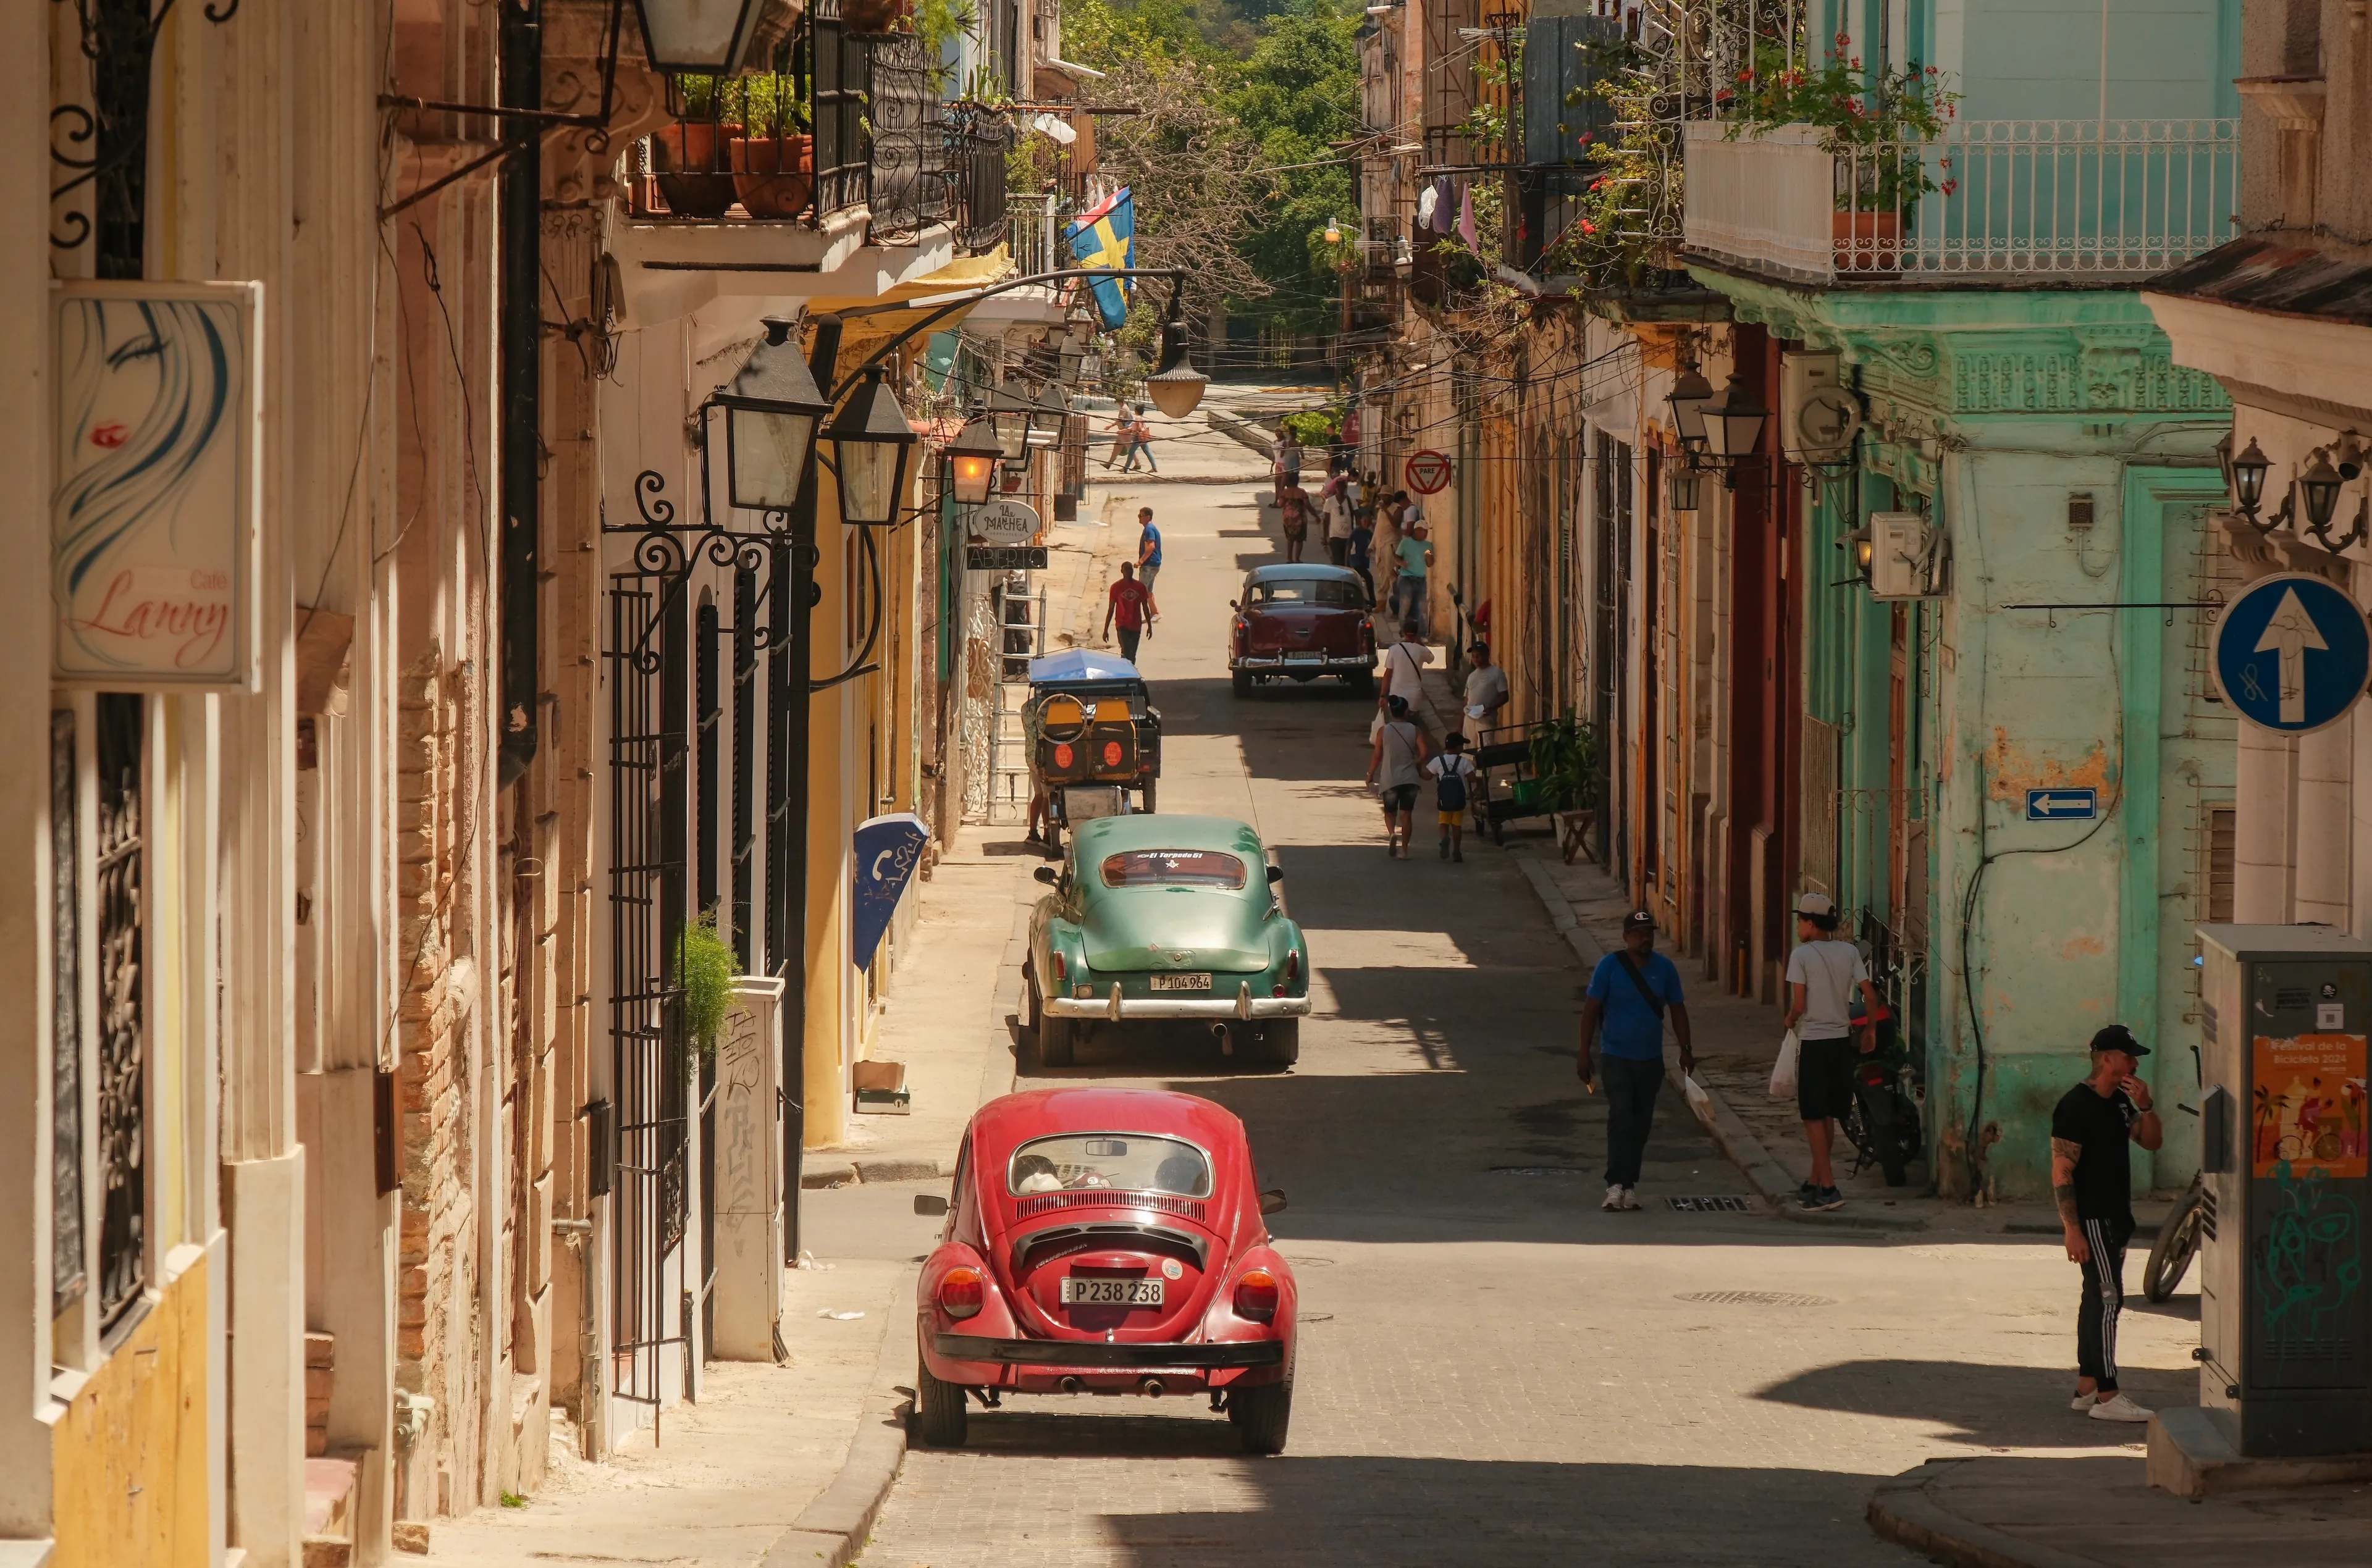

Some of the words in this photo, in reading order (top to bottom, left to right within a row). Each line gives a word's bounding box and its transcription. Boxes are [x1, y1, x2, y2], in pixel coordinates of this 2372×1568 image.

[984, 516, 1028, 533] MANCHEGA
[969, 548, 1046, 568] ABIERTO
[1159, 977, 1166, 989] P
[1168, 977, 1188, 989] 104
[1190, 976, 1210, 988] 964
[2318, 1041, 2333, 1050] de
[2336, 1041, 2347, 1050] la
[2274, 1054, 2319, 1063] Bicicleta
[2322, 1054, 2347, 1063] 2024
[1076, 1283, 1086, 1301] P
[1090, 1283, 1123, 1301] 238
[1128, 1284, 1160, 1302] 238
